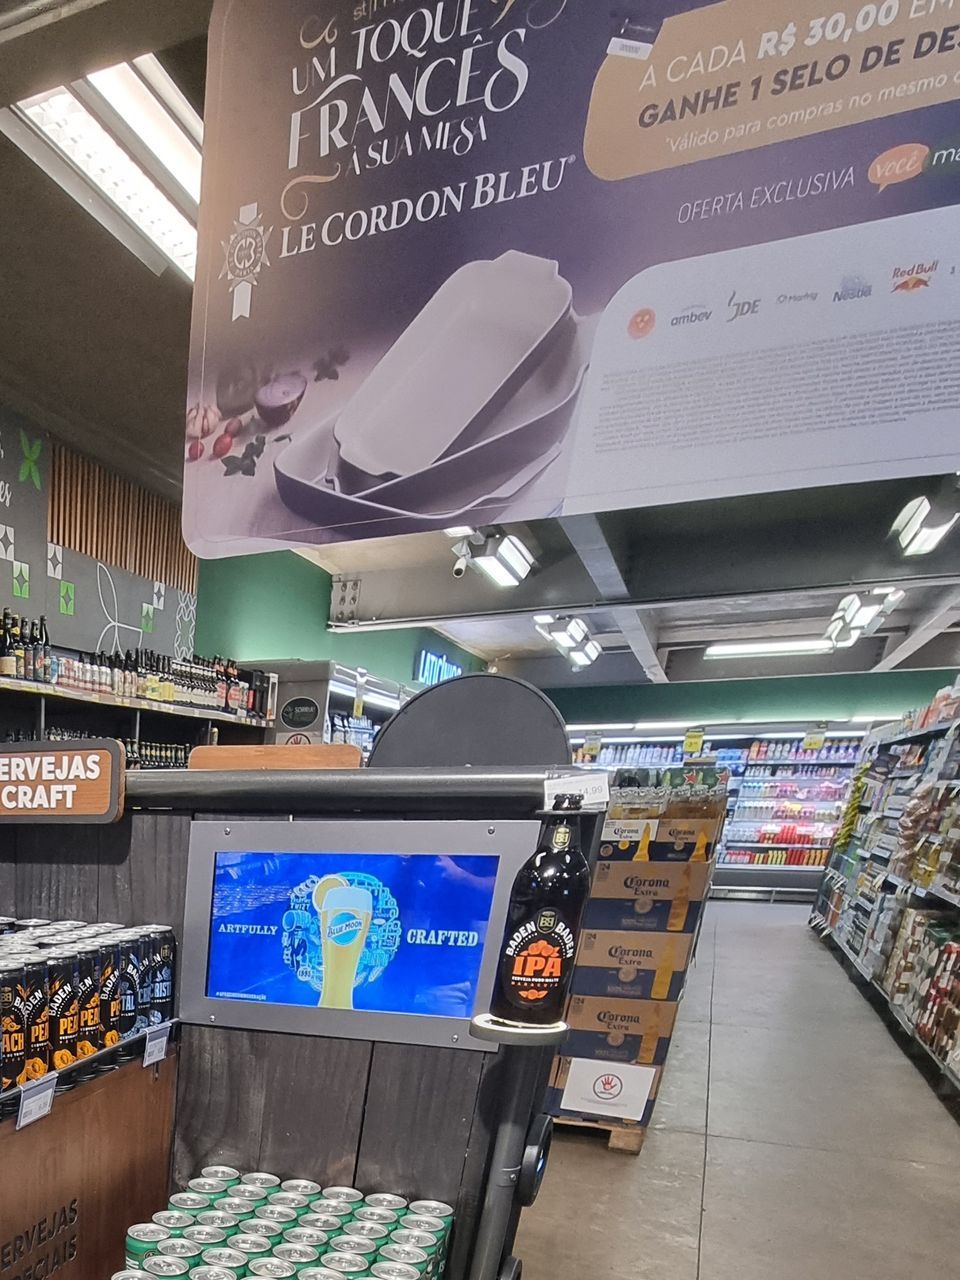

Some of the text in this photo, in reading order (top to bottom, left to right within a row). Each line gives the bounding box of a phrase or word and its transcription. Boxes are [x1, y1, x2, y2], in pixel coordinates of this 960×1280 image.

[292, 0, 482, 95] UM TOQUE
[639, 2, 900, 92] A CADA R$ 30,00
[638, 25, 960, 128] GANHE 1 SELO DE DE
[288, 28, 529, 169] FRANCÊS
[723, 75, 948, 141] para compras no mesmo
[366, 131, 413, 169] SUA
[420, 115, 487, 156] MESA
[678, 166, 855, 224] OFERTA EXCLUSIVA
[279, 223, 316, 258] LE
[321, 182, 466, 245] CORDON
[916, 260, 939, 275] Bull
[670, 310, 713, 327] ambev
[1, 785, 77, 809] CRAFT
[623, 875, 670, 889] Corona
[633, 888, 658, 897] Extra
[218, 923, 279, 936] ARTFULLY
[406, 927, 479, 948] CRAFTED
[505, 921, 575, 959] BADEN BADEN
[608, 945, 653, 958] Corona
[618, 957, 642, 966] Extra
[511, 955, 562, 978] IPA
[48, 984, 72, 1016] BADEN
[596, 1010, 640, 1025] Corona
[607, 1022, 630, 1032] Extra
